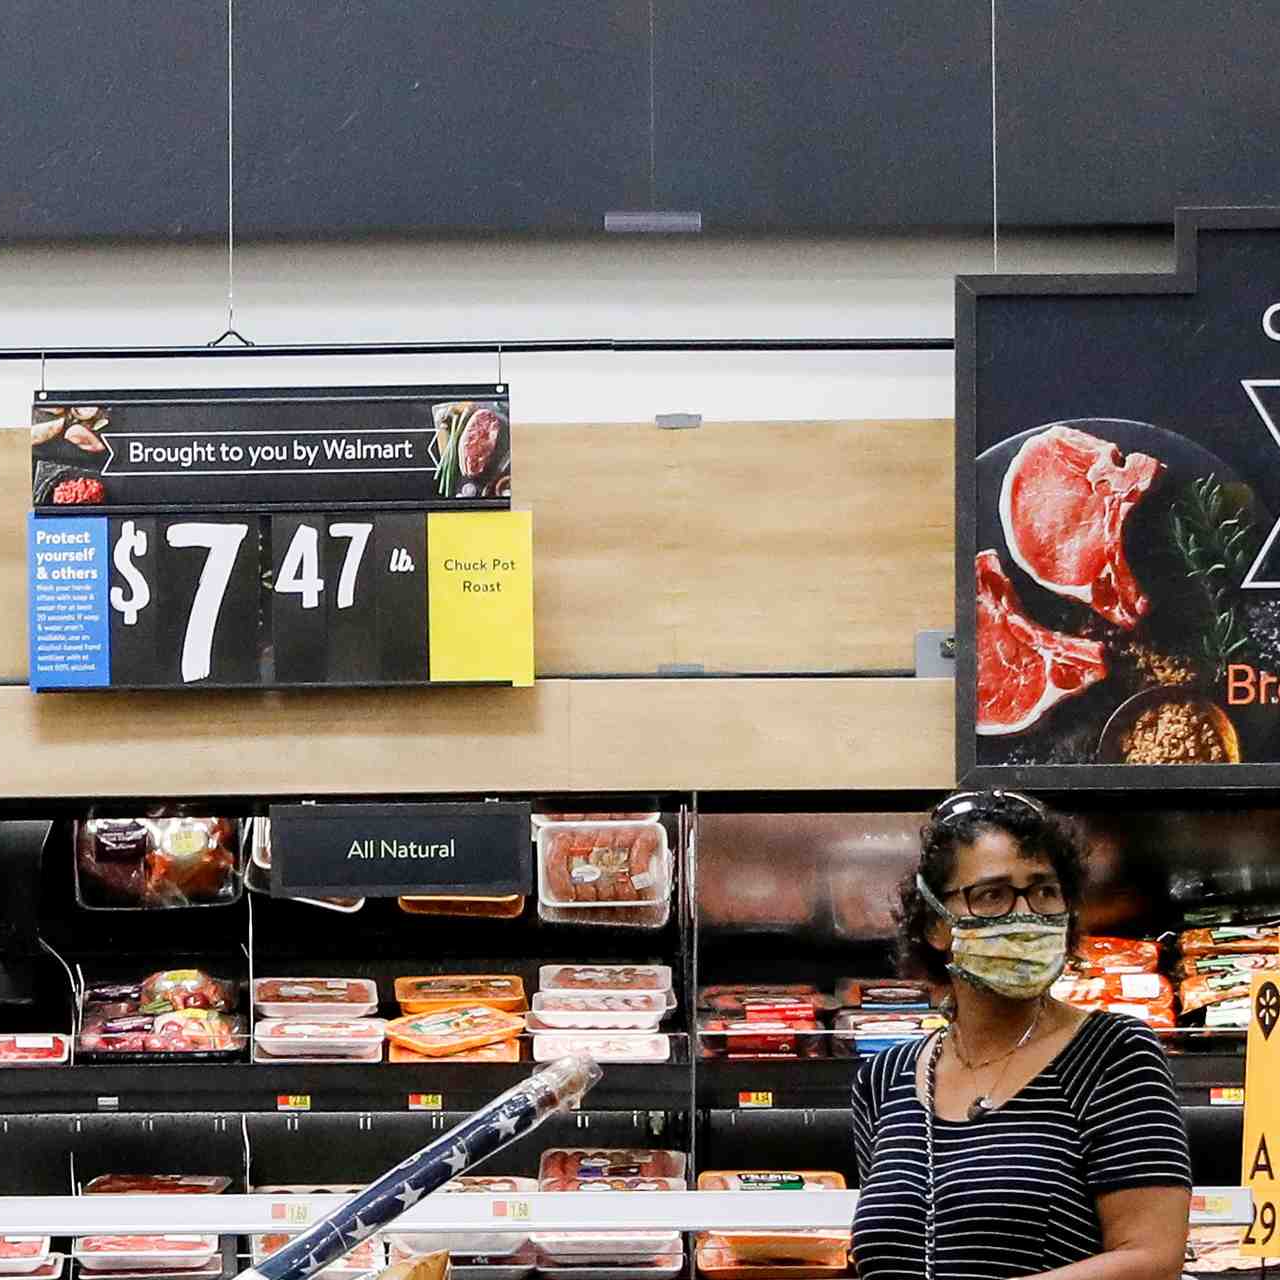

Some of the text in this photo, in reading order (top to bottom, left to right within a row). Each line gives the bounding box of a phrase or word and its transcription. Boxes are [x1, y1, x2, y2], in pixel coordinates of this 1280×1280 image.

[129, 438, 414, 467] Brought to you by Walmart
[36, 531, 90, 545] Protect
[36, 548, 96, 566] yourself
[443, 558, 516, 572] Chuck Pot
[36, 567, 98, 580] & others
[462, 580, 501, 594] Roast
[347, 838, 455, 859] All Natural
[1250, 1134, 1275, 1181] A
